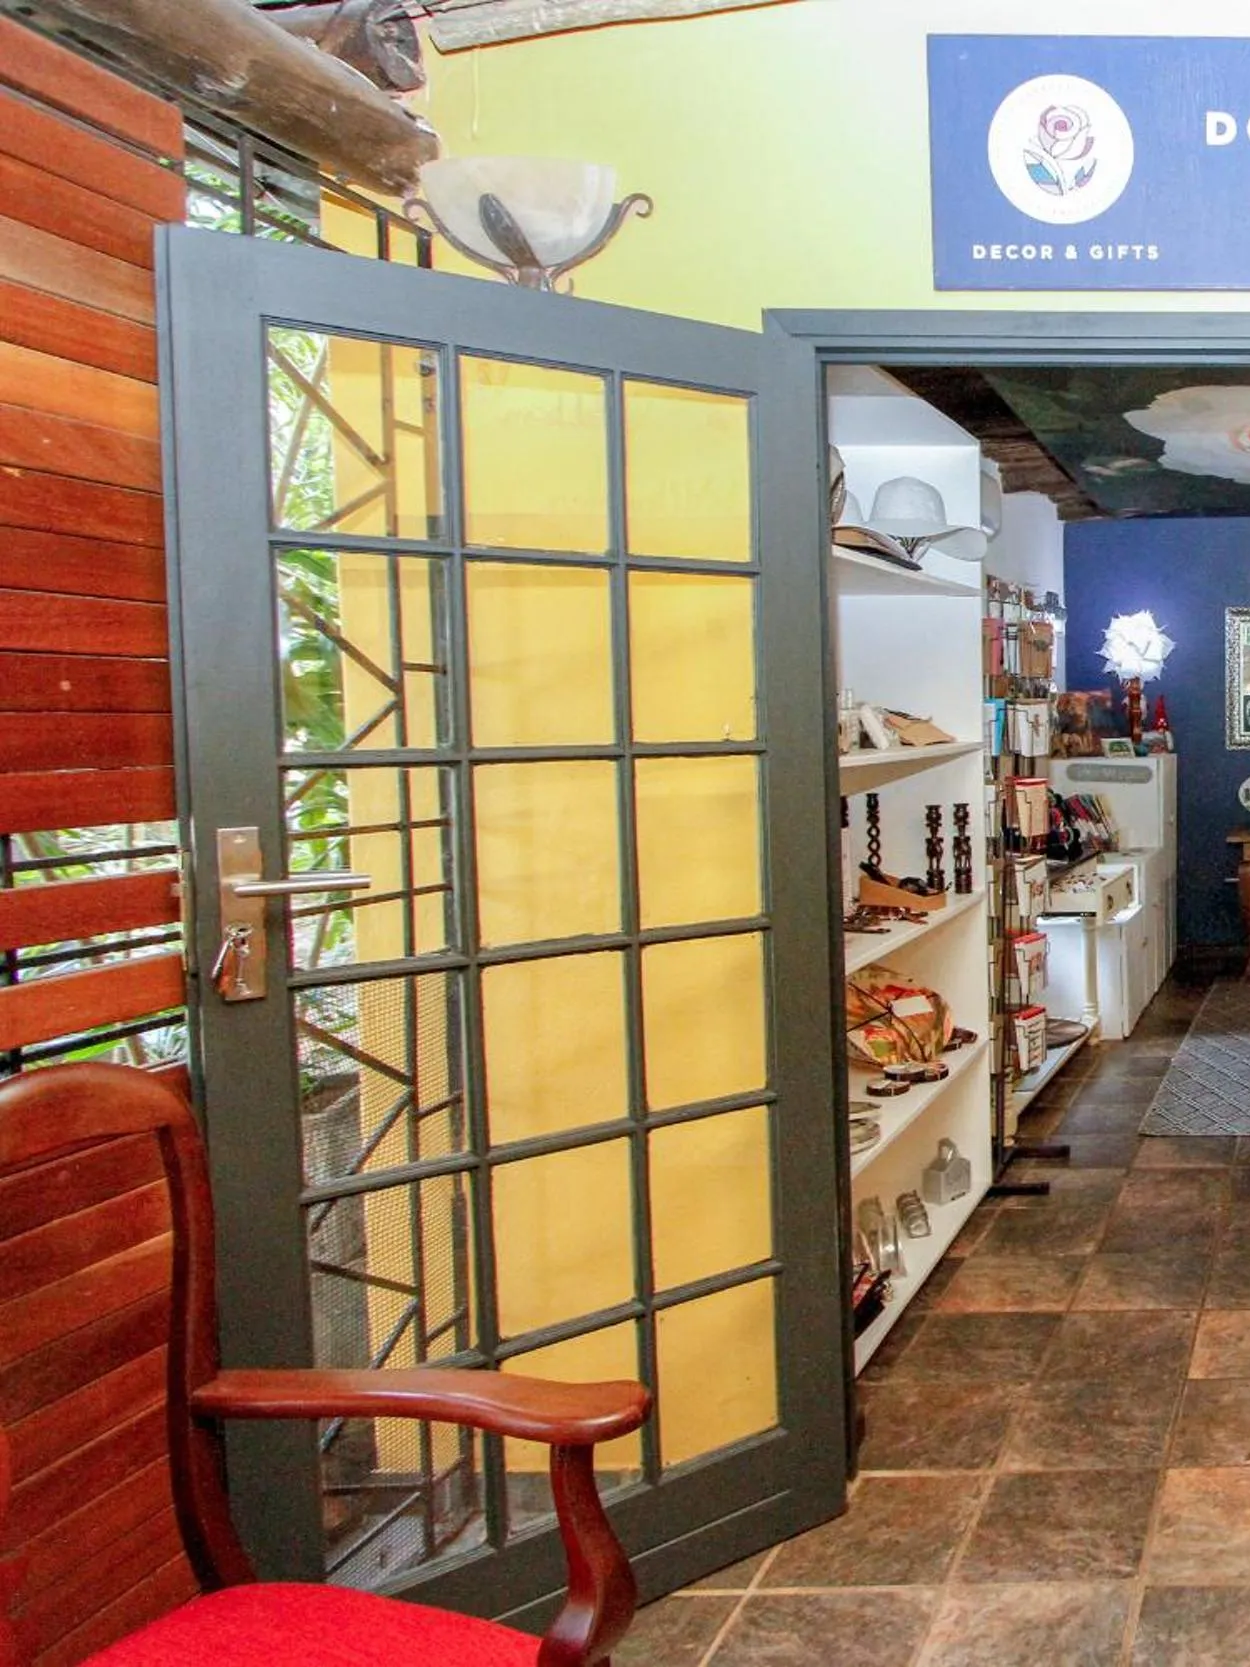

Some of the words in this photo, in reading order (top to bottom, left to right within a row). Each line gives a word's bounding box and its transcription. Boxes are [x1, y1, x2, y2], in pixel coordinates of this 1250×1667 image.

[972, 244, 1054, 260] DECOR
[1065, 244, 1078, 260] &
[1089, 244, 1159, 260] GIFTS
